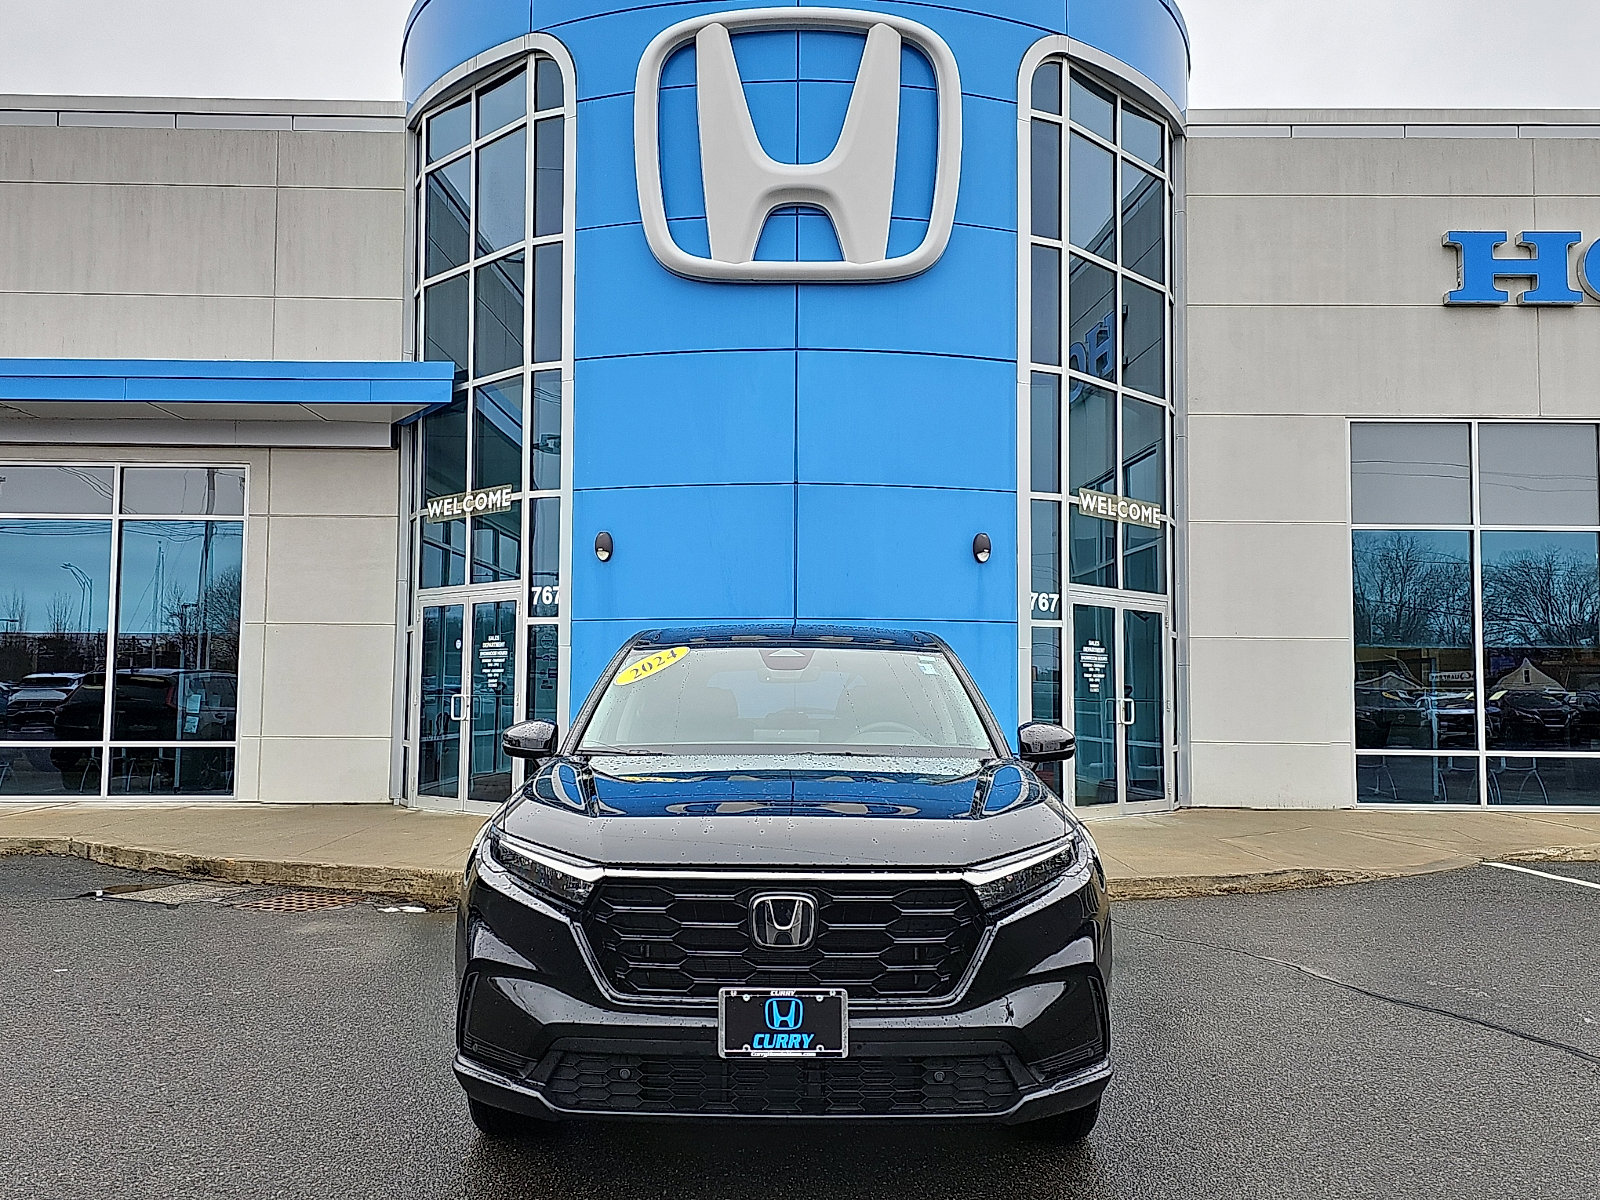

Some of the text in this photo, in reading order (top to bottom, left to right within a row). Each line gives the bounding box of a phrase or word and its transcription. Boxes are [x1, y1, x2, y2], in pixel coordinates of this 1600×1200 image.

[1442, 230, 1600, 305] H
[427, 488, 512, 519] WELCOME
[1080, 492, 1161, 525] WELCOME
[531, 586, 560, 605] 767
[1030, 592, 1060, 613] 767
[630, 649, 678, 680] 2024
[752, 1033, 815, 1049] CURRY
